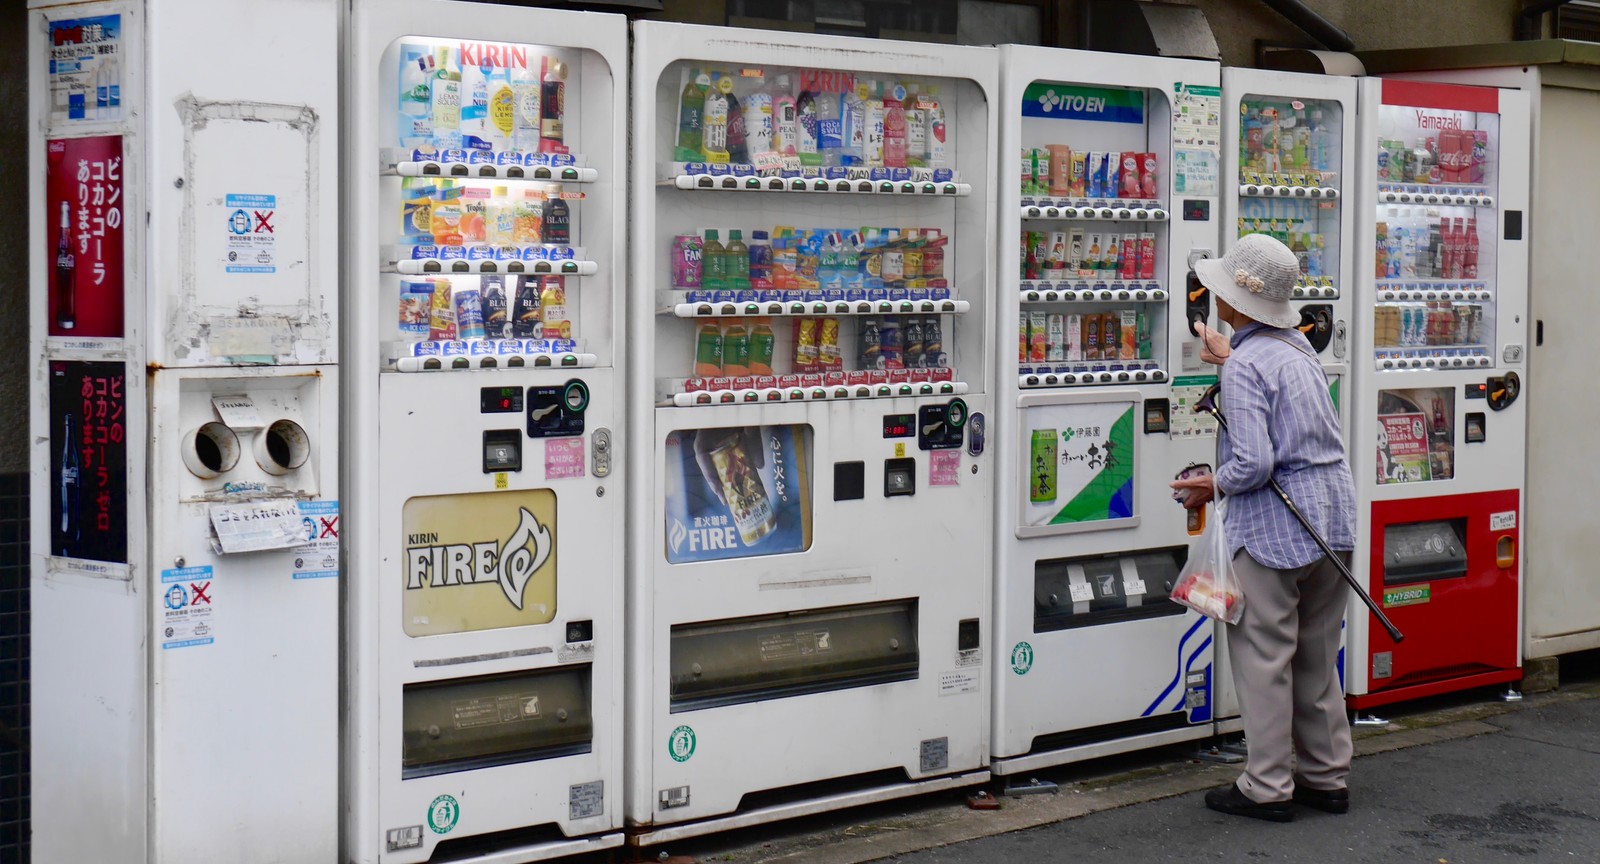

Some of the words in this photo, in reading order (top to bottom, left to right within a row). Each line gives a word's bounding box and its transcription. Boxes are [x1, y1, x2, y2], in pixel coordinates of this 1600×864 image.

[459, 42, 527, 69] KIRIN
[801, 69, 855, 93] KIRIN
[1058, 95, 1085, 111] ITO
[1086, 97, 1105, 113] EN
[1415, 110, 1462, 130] Yamazaki
[77, 158, 91, 254] あります
[107, 155, 121, 229] ビンの
[92, 161, 106, 286] コカ・コーラ
[81, 375, 95, 468] あります
[96, 378, 108, 487] コカ・コーラ
[110, 375, 123, 443] ビンの
[770, 436, 788, 502] 心に火を。
[406, 539, 499, 590] FIRE
[408, 532, 438, 545] KIRIN
[688, 527, 737, 552] FIRE
